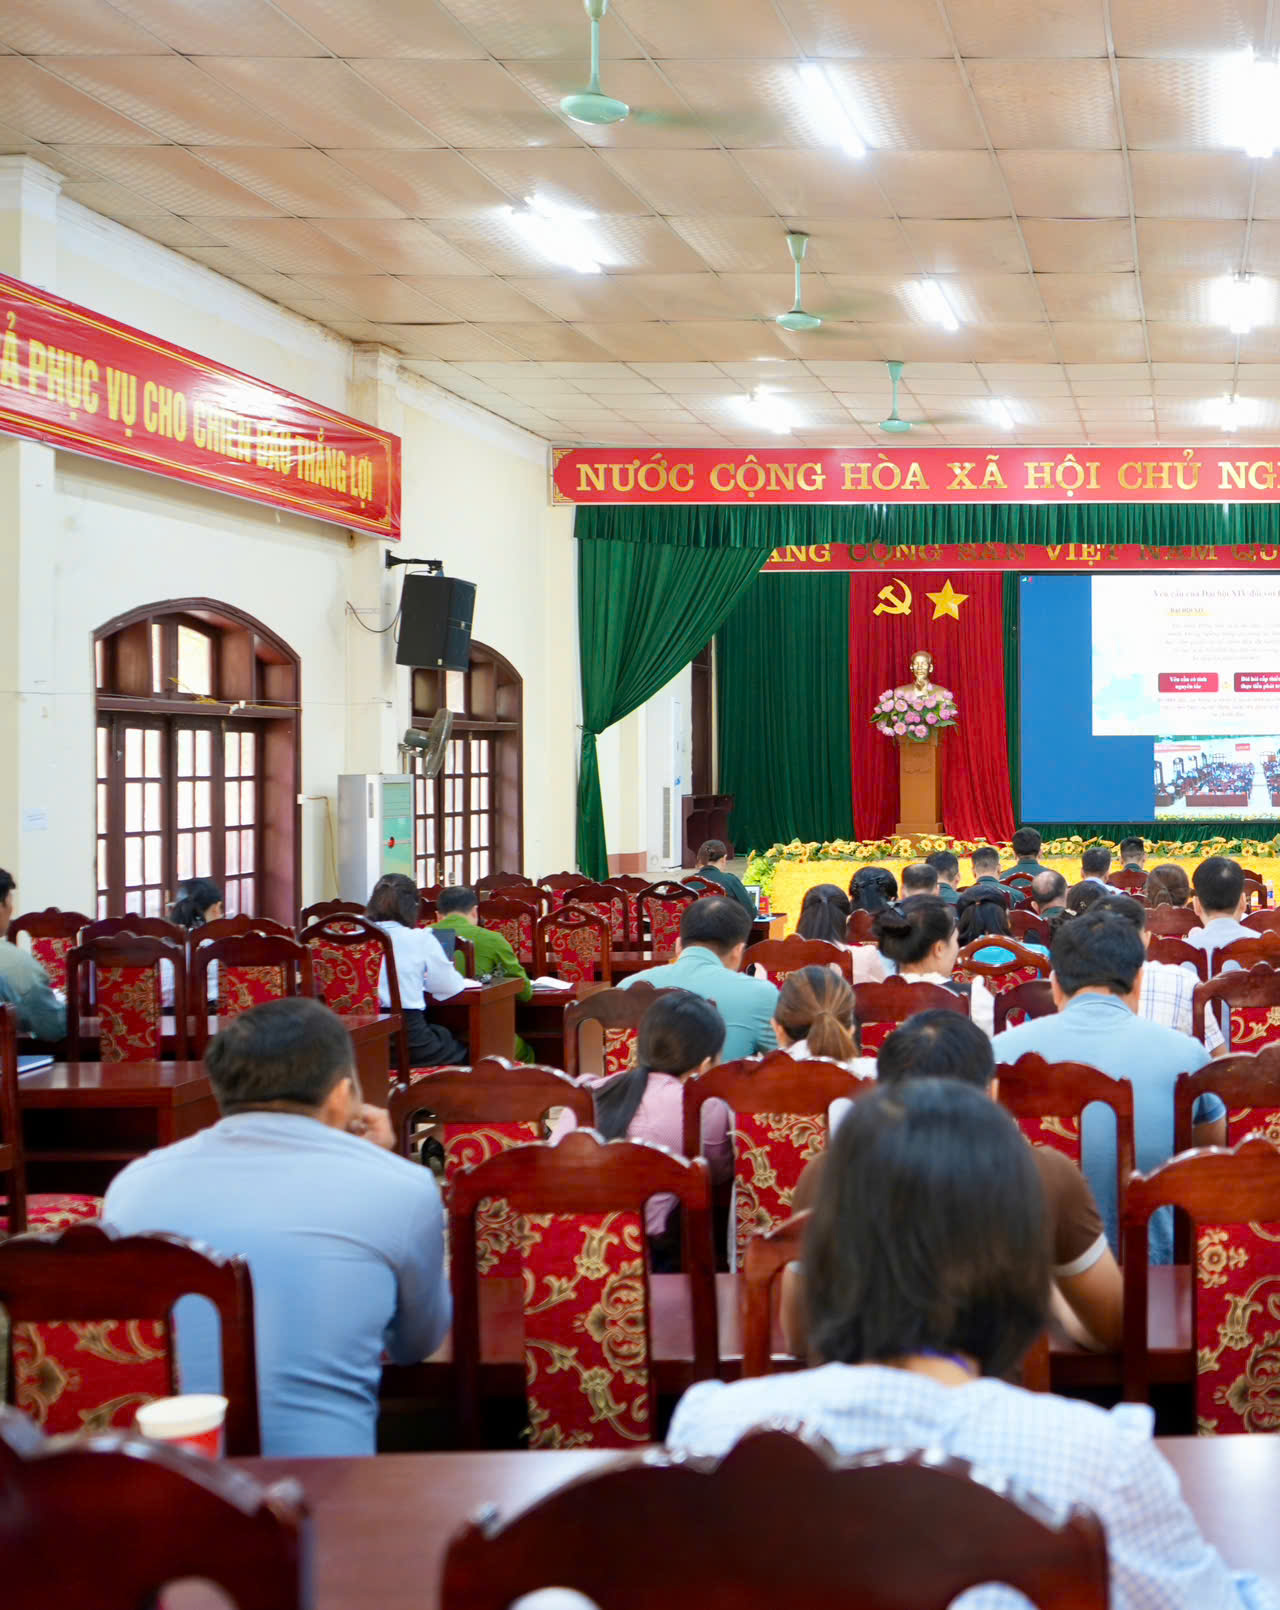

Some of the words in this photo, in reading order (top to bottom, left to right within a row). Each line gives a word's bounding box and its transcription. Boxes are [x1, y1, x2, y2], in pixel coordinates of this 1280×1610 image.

[29, 338, 100, 421] PHỤC
[106, 366, 138, 438] VỤ
[143, 381, 187, 442] CHO
[351, 455, 373, 509] LỢI
[576, 453, 694, 492] NƯỚC
[709, 454, 826, 498] CỘNG
[841, 453, 930, 490] HÒA
[946, 455, 1008, 490] XÃ
[1024, 453, 1101, 497] HỘI
[1117, 448, 1203, 490] CHỦ
